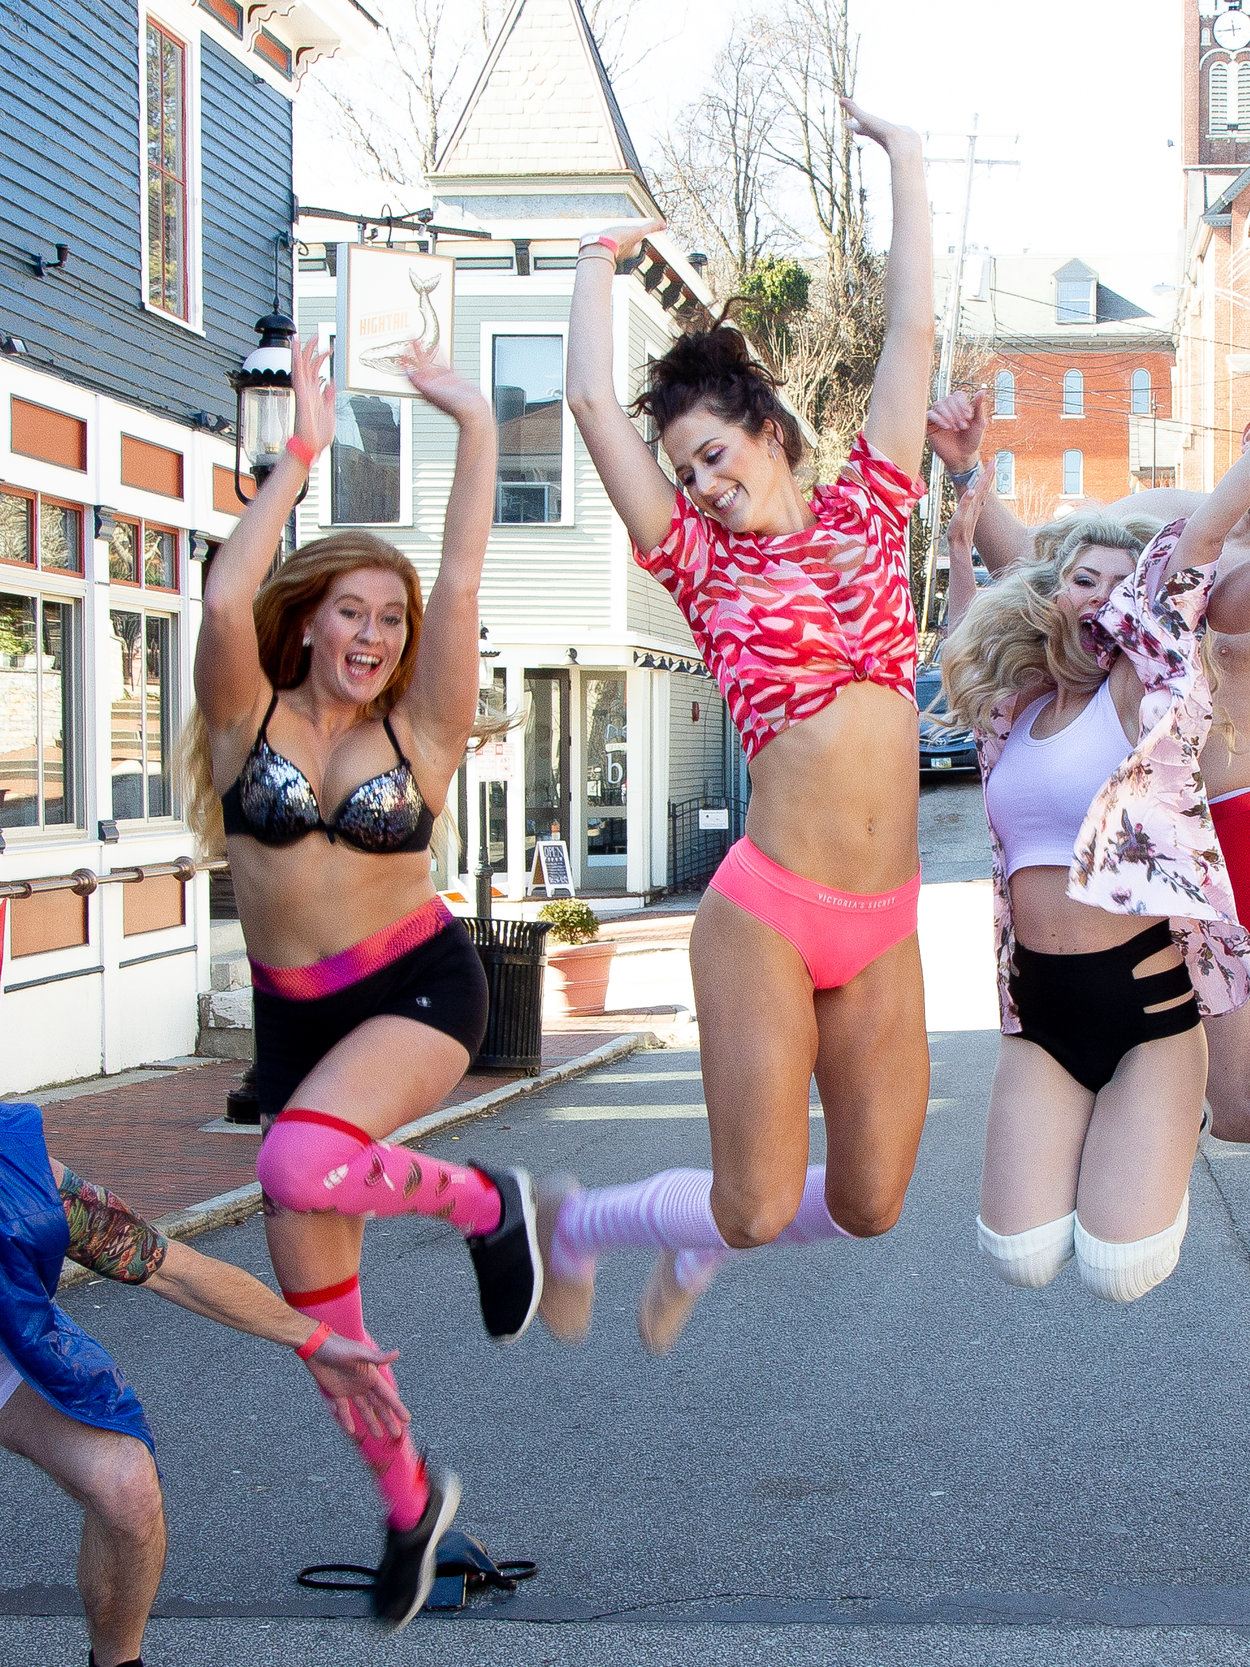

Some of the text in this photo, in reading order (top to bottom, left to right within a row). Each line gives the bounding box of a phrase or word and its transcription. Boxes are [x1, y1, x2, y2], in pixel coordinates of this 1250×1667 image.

[359, 311, 409, 337] HIGHTAIL
[543, 846, 565, 858] OPEN
[817, 892, 896, 909] VICTORIA'S SECRET
